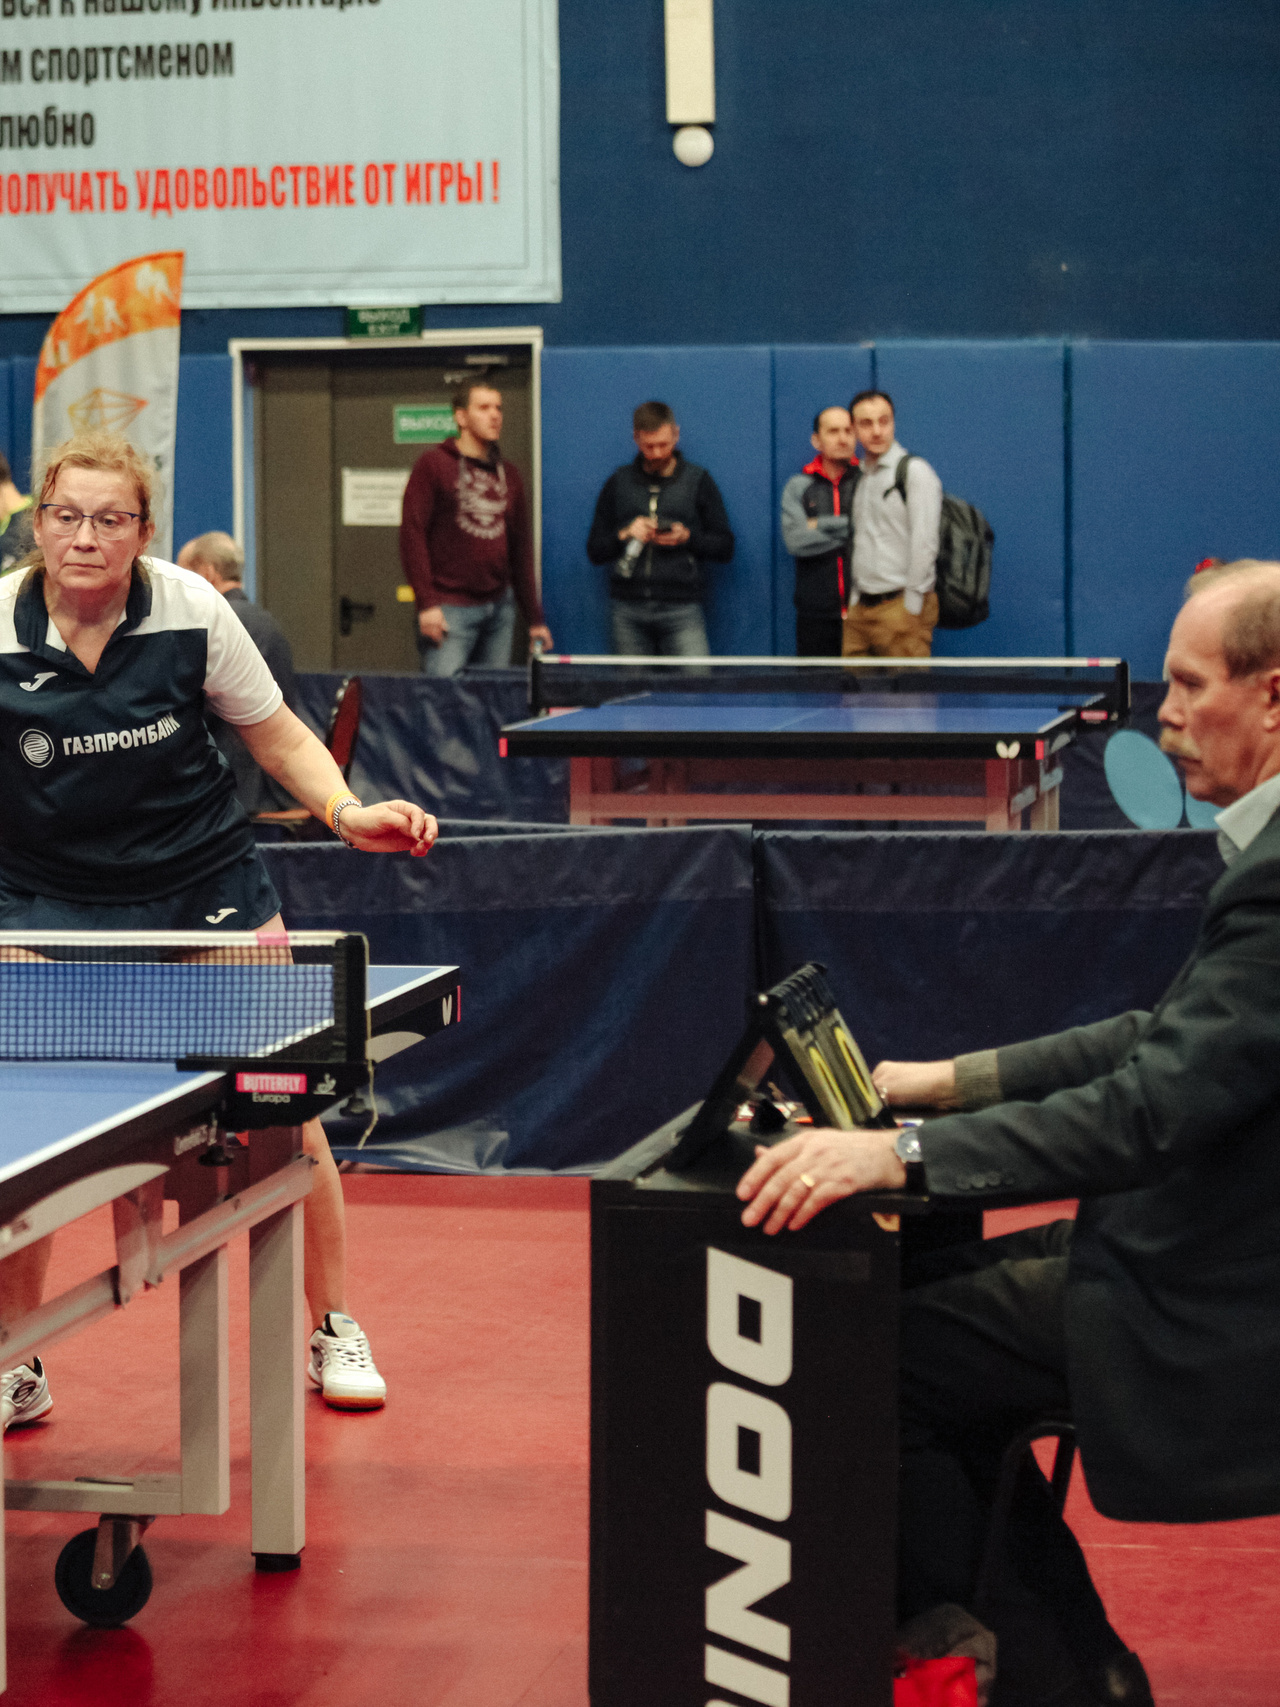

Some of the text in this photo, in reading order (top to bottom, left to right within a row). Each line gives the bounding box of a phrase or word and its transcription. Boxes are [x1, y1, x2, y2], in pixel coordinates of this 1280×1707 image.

[31, 41, 235, 86] спортсменом
[135, 164, 356, 219] УДОВОЛЬСТВИЕ
[364, 162, 397, 206] ОТ
[62, 712, 181, 756] ГАЗПРОМБАНК
[243, 1073, 301, 1091] BUTTERFLY
[252, 1092, 291, 1105] Europa
[705, 1246, 793, 1707] DONI
